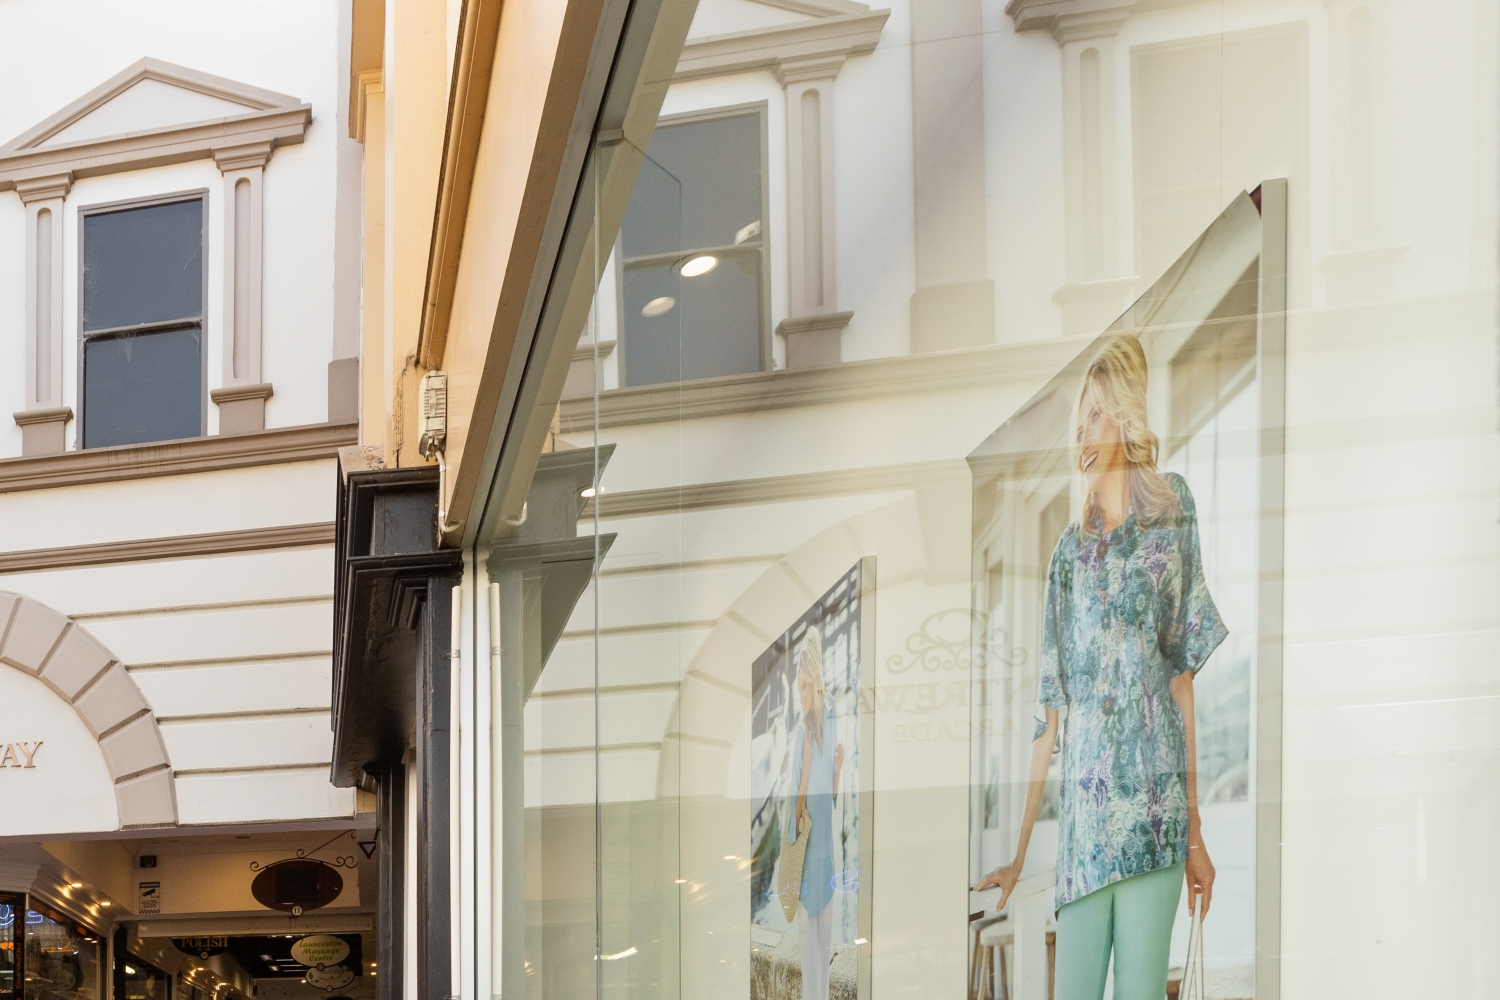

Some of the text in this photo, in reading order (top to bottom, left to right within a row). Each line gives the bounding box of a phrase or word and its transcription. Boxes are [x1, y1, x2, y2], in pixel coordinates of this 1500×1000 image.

[181, 937, 229, 948] POLISH
[299, 940, 343, 948] Launceston
[302, 947, 340, 956] Massage
[308, 954, 334, 962] Centre
[14, 942, 22, 990] REPAIRS
